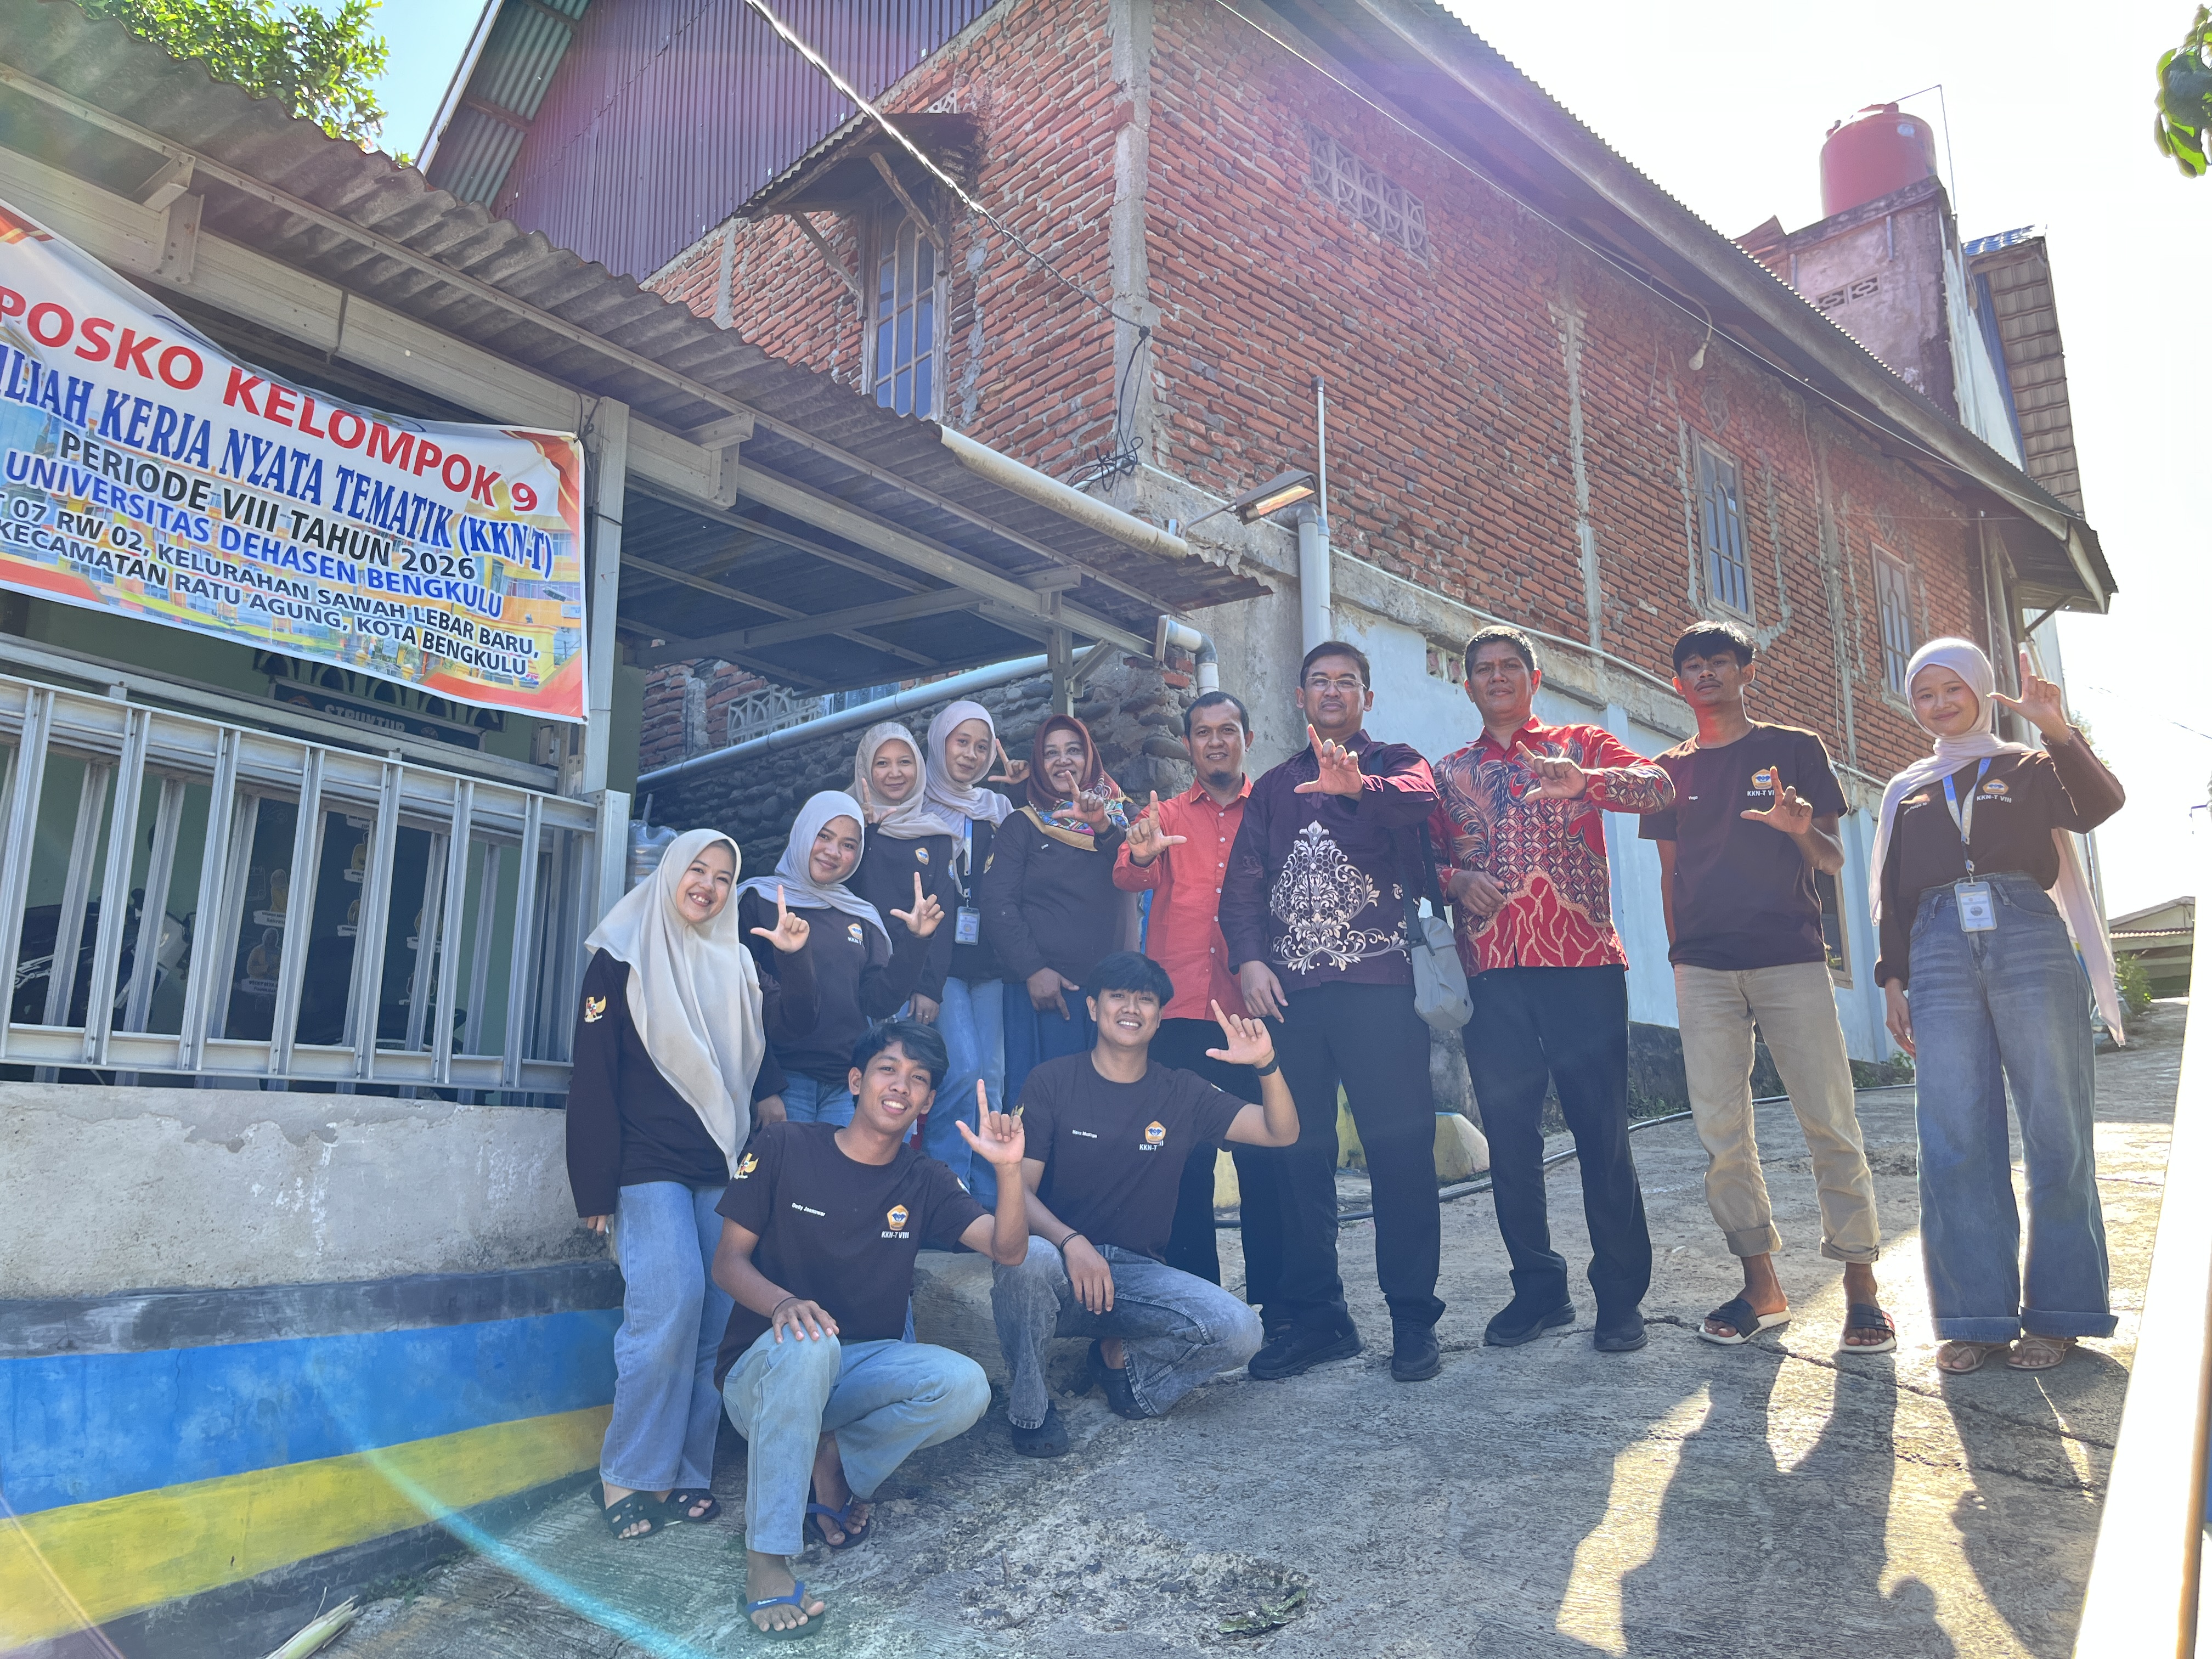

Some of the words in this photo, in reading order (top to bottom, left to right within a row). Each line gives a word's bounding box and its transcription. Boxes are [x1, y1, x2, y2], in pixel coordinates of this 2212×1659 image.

[0, 285, 204, 390] POSKO
[223, 366, 501, 507] KELOMPOK
[511, 483, 538, 511] 9
[6, 451, 210, 542] UNIVERSITAS
[221, 525, 356, 584] DEHASEN
[368, 568, 502, 617] BENGKULU
[60, 430, 211, 511] PERIODE
[224, 488, 279, 532] VIII
[291, 510, 390, 567] TAHUN
[402, 548, 475, 579] 2026
[98, 388, 211, 469] KERJA
[219, 428, 323, 505] NYATA
[332, 465, 454, 548] TEMATIK
[459, 515, 552, 579] (KKN-T)
[0, 519, 166, 586] KECAMATAN
[175, 574, 240, 605] RATU
[250, 594, 349, 631] AGUNG,
[358, 618, 416, 645] KOTA
[422, 632, 526, 675] BENGKULU
[14, 500, 47, 522] 07
[57, 511, 104, 540] RW
[111, 526, 149, 556] 02,
[159, 543, 309, 601] KELURAHAN
[318, 589, 404, 619] SAWAH
[414, 607, 474, 640] LEBAR
[480, 627, 539, 658] BARU,
